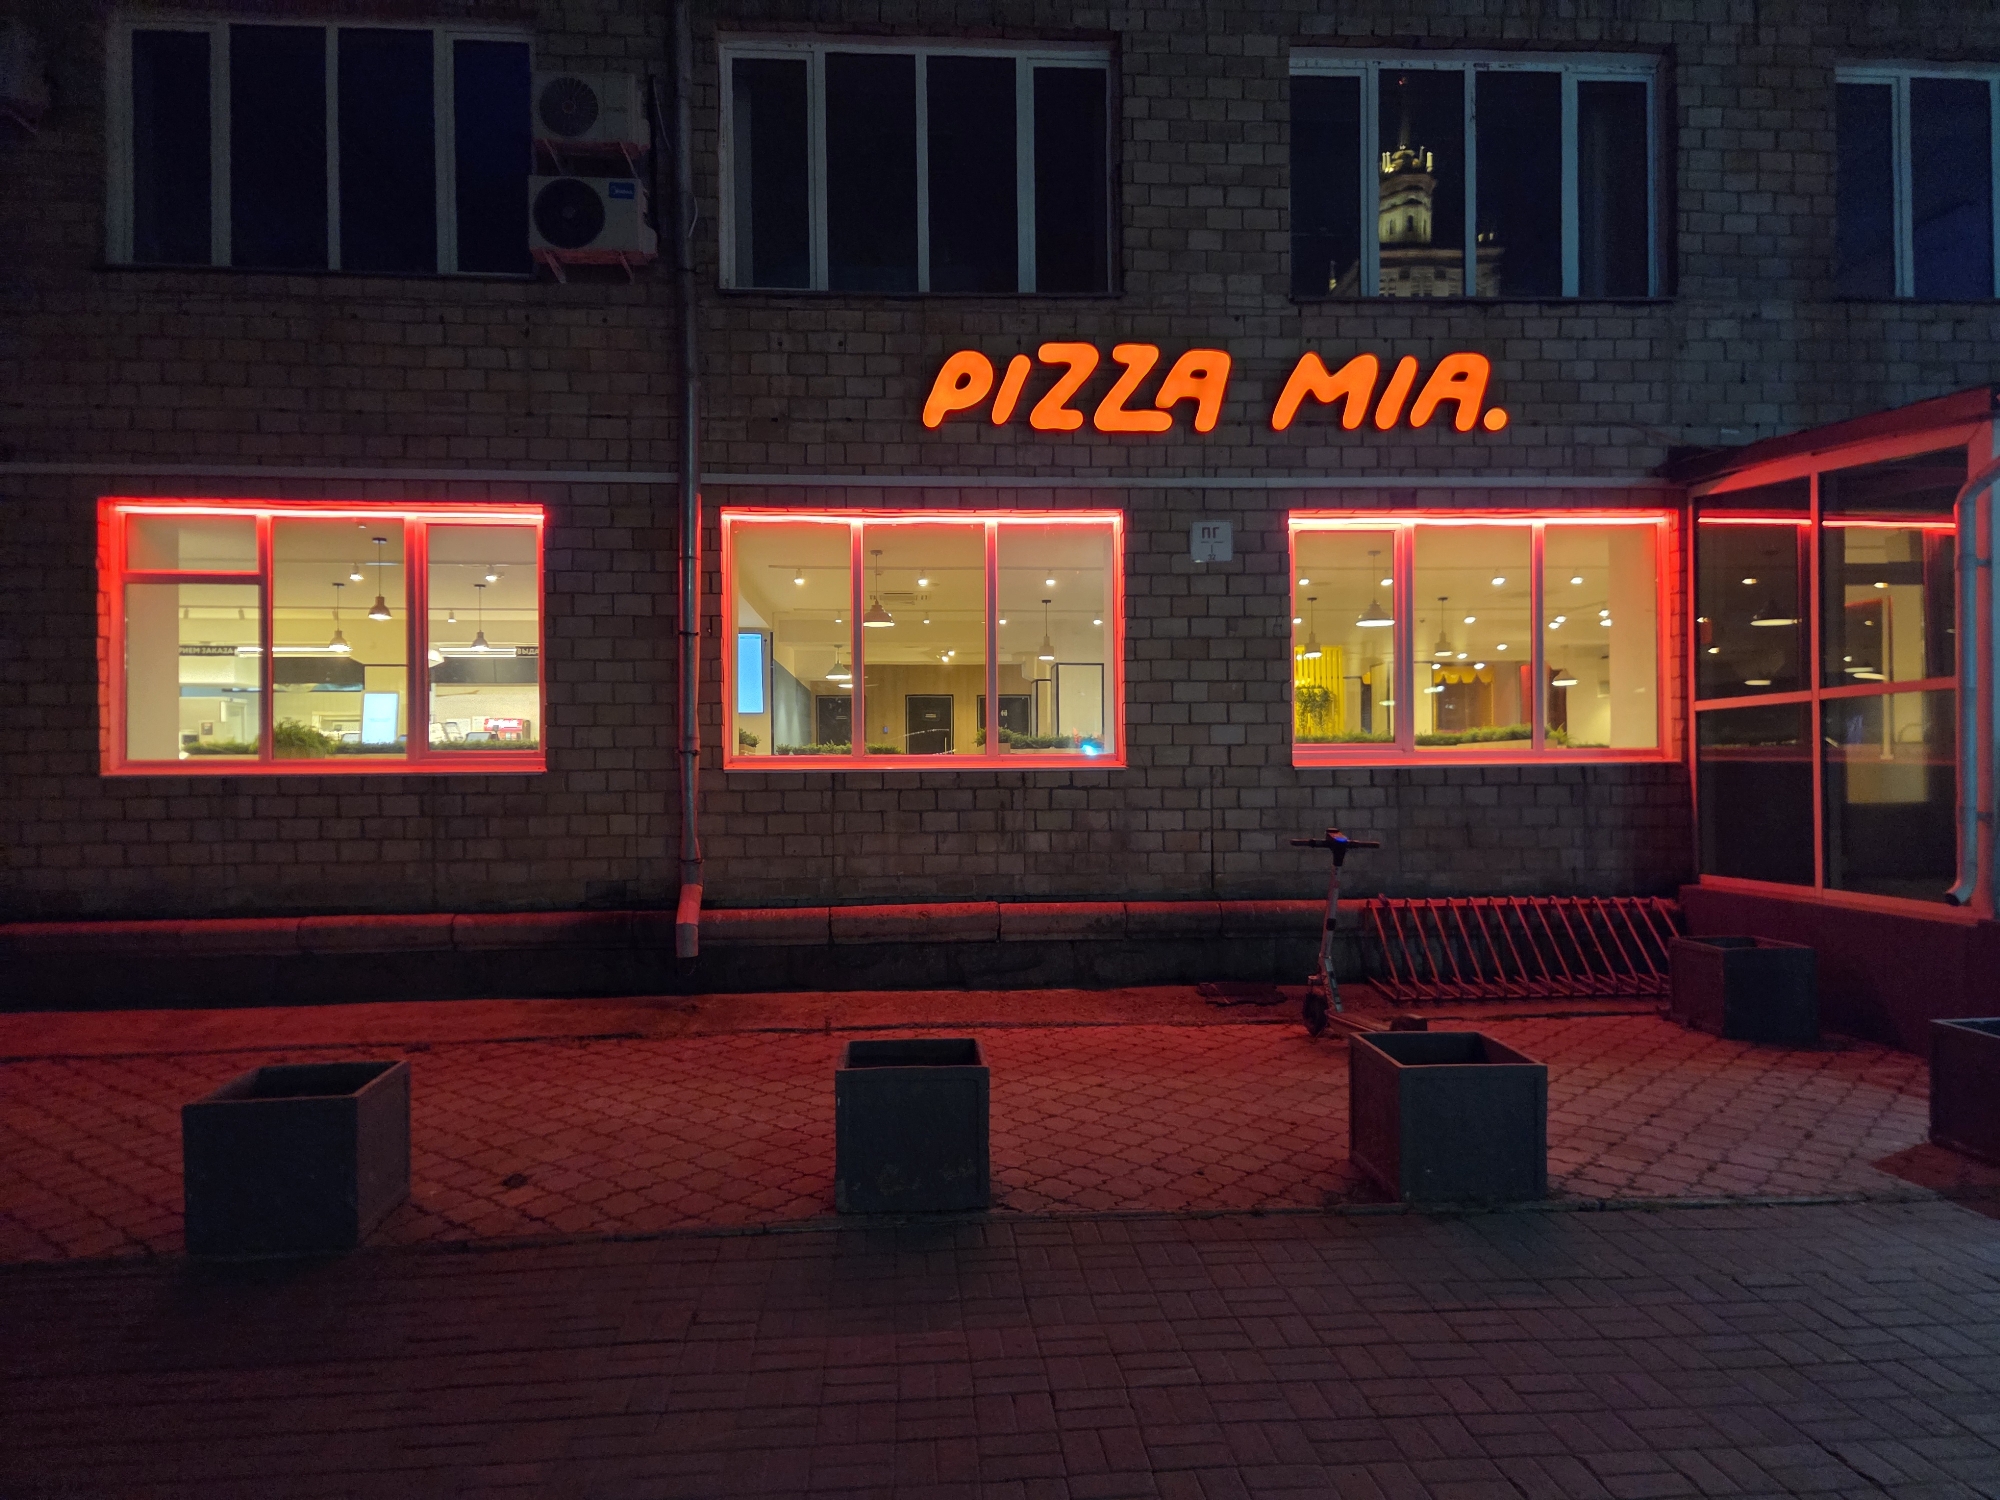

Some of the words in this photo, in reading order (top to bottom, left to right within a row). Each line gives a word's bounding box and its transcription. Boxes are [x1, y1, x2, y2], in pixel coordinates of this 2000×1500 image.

[922, 341, 1232, 432] PIZZA
[1271, 351, 1508, 432] MIA.
[1202, 527, 1220, 539] ПГ
